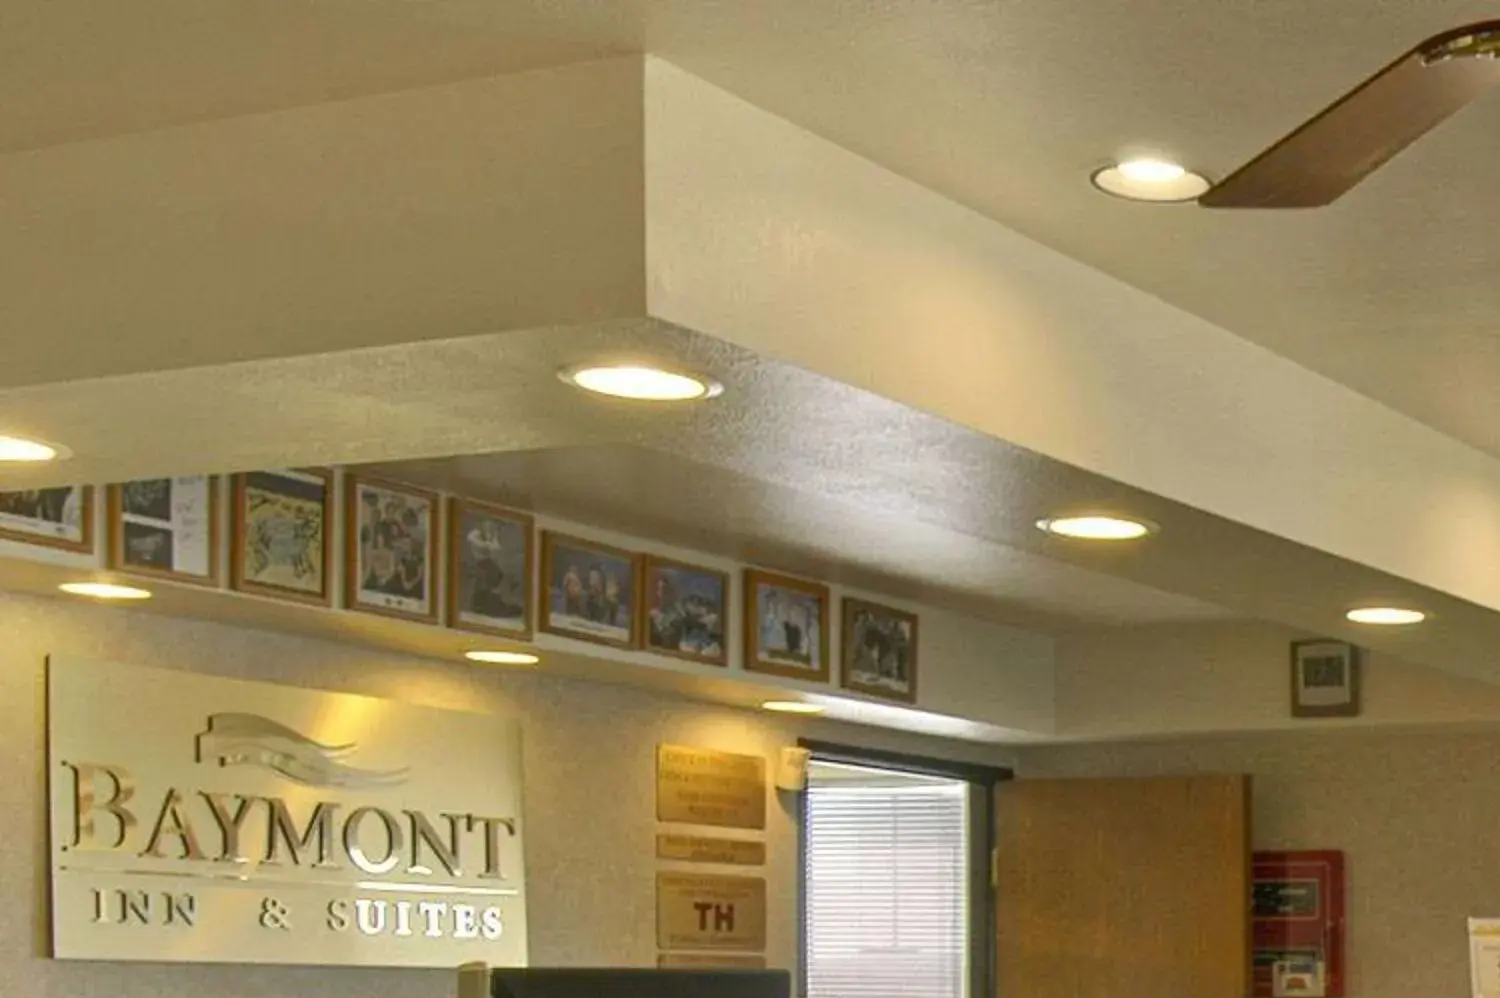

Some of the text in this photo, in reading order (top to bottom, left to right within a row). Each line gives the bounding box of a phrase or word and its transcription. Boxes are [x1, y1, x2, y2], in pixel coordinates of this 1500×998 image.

[61, 760, 516, 880] BAYMONT
[90, 888, 503, 940] INN & SUITES
